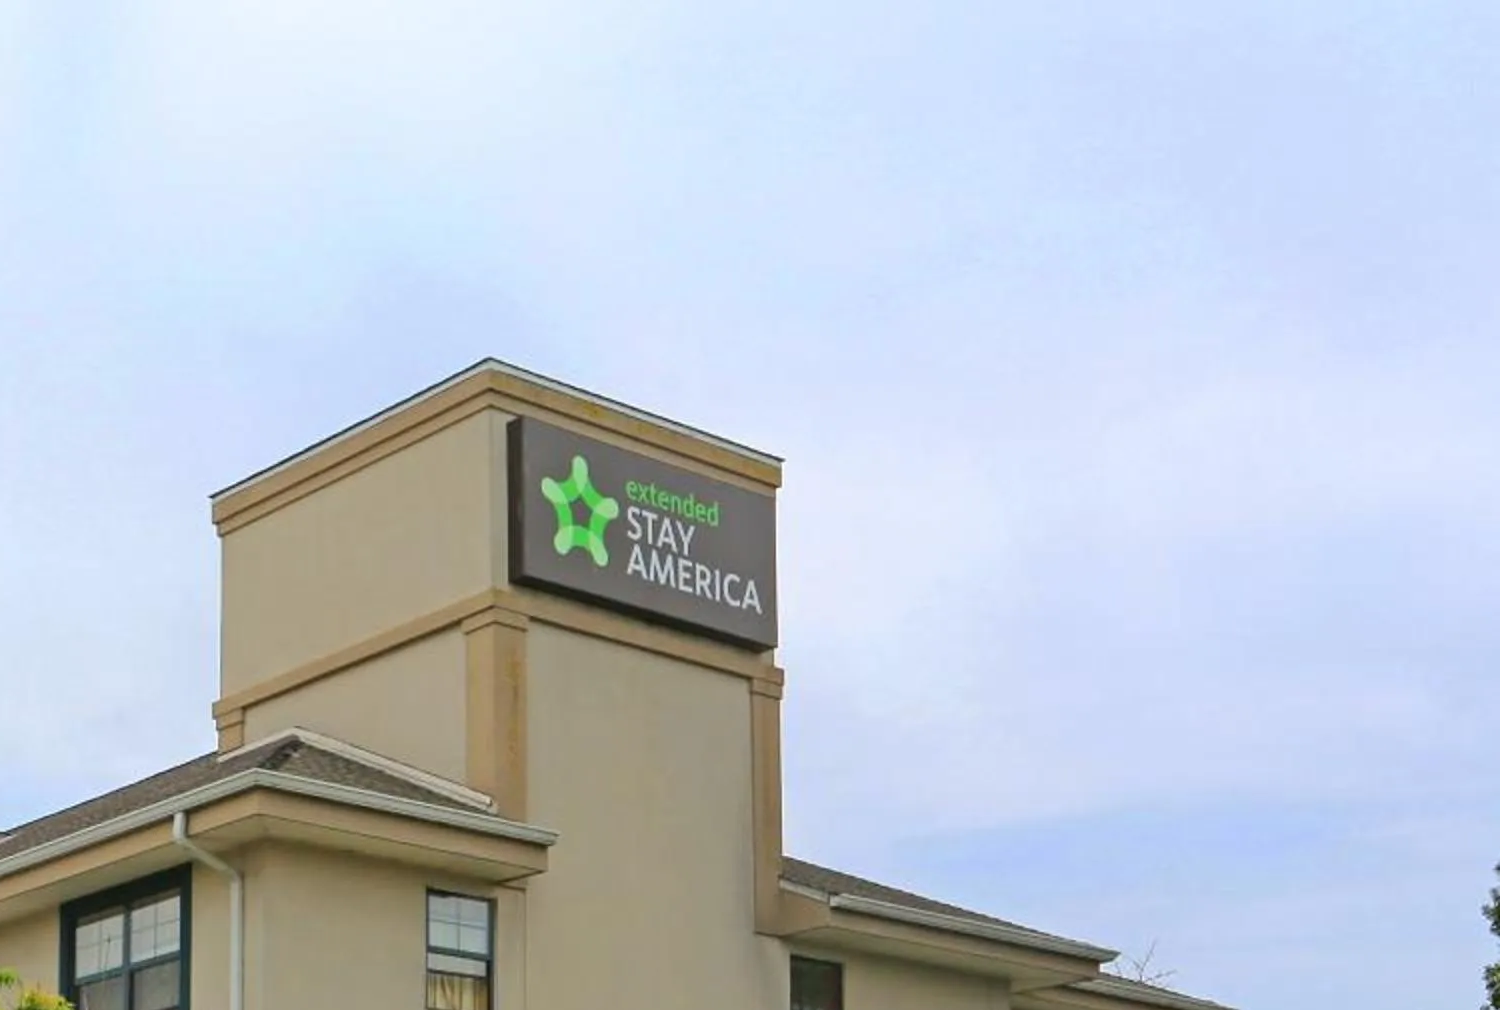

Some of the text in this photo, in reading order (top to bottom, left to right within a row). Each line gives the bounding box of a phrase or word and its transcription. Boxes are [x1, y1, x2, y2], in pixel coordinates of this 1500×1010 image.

[625, 480, 719, 527] extended
[626, 505, 695, 556] STAY
[626, 544, 762, 615] AMERICA
